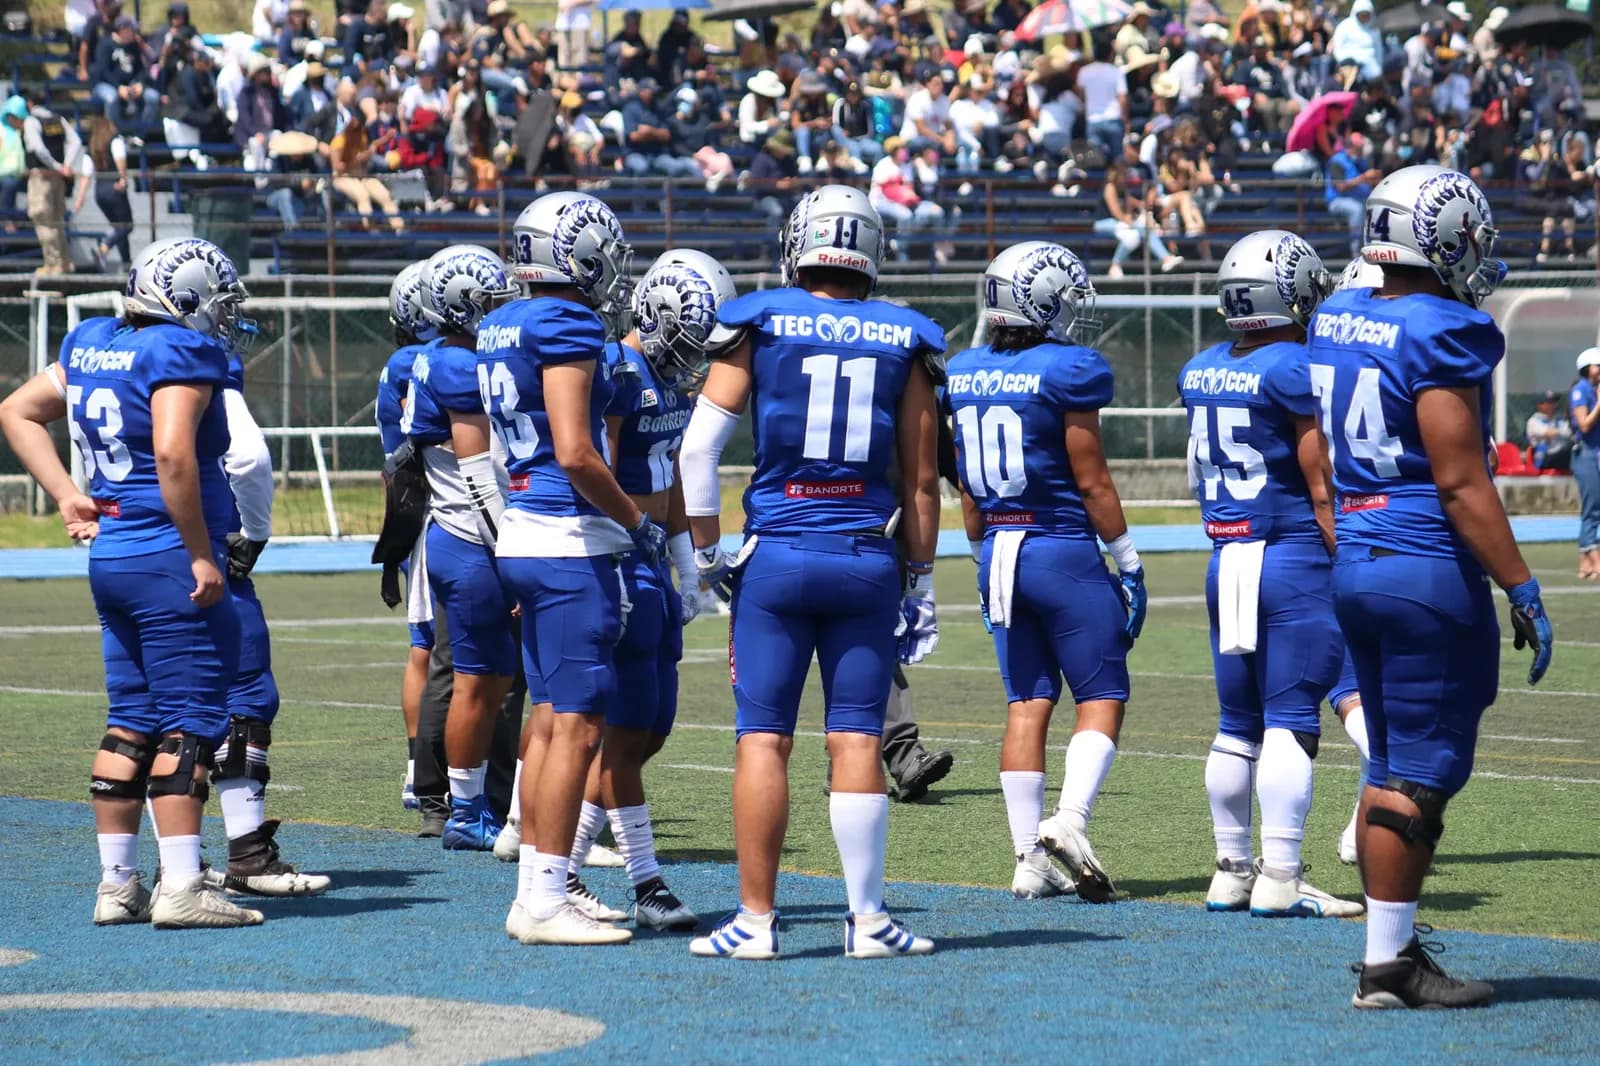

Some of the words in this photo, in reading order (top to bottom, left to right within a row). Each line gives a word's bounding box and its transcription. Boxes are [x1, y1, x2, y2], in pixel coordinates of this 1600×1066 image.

[832, 216, 858, 250] 11
[818, 254, 868, 269] Riddell
[770, 315, 813, 336] TEC
[862, 321, 912, 348] CCM
[1357, 320, 1399, 349] CCM
[101, 350, 136, 371] CCM
[948, 373, 972, 395] TEC
[1002, 373, 1040, 394] CCM
[1183, 369, 1203, 390] TEC
[1225, 370, 1261, 395] CCM
[638, 408, 692, 433] BORREGO
[801, 354, 877, 462] 11
[1310, 363, 1404, 478] 74
[66, 384, 133, 482] 53
[956, 405, 1028, 498] 10
[1186, 405, 1268, 501] 45
[805, 484, 863, 494] BANORTE
[993, 514, 1033, 522] BANORTE
[1214, 525, 1249, 534] BANORTE
